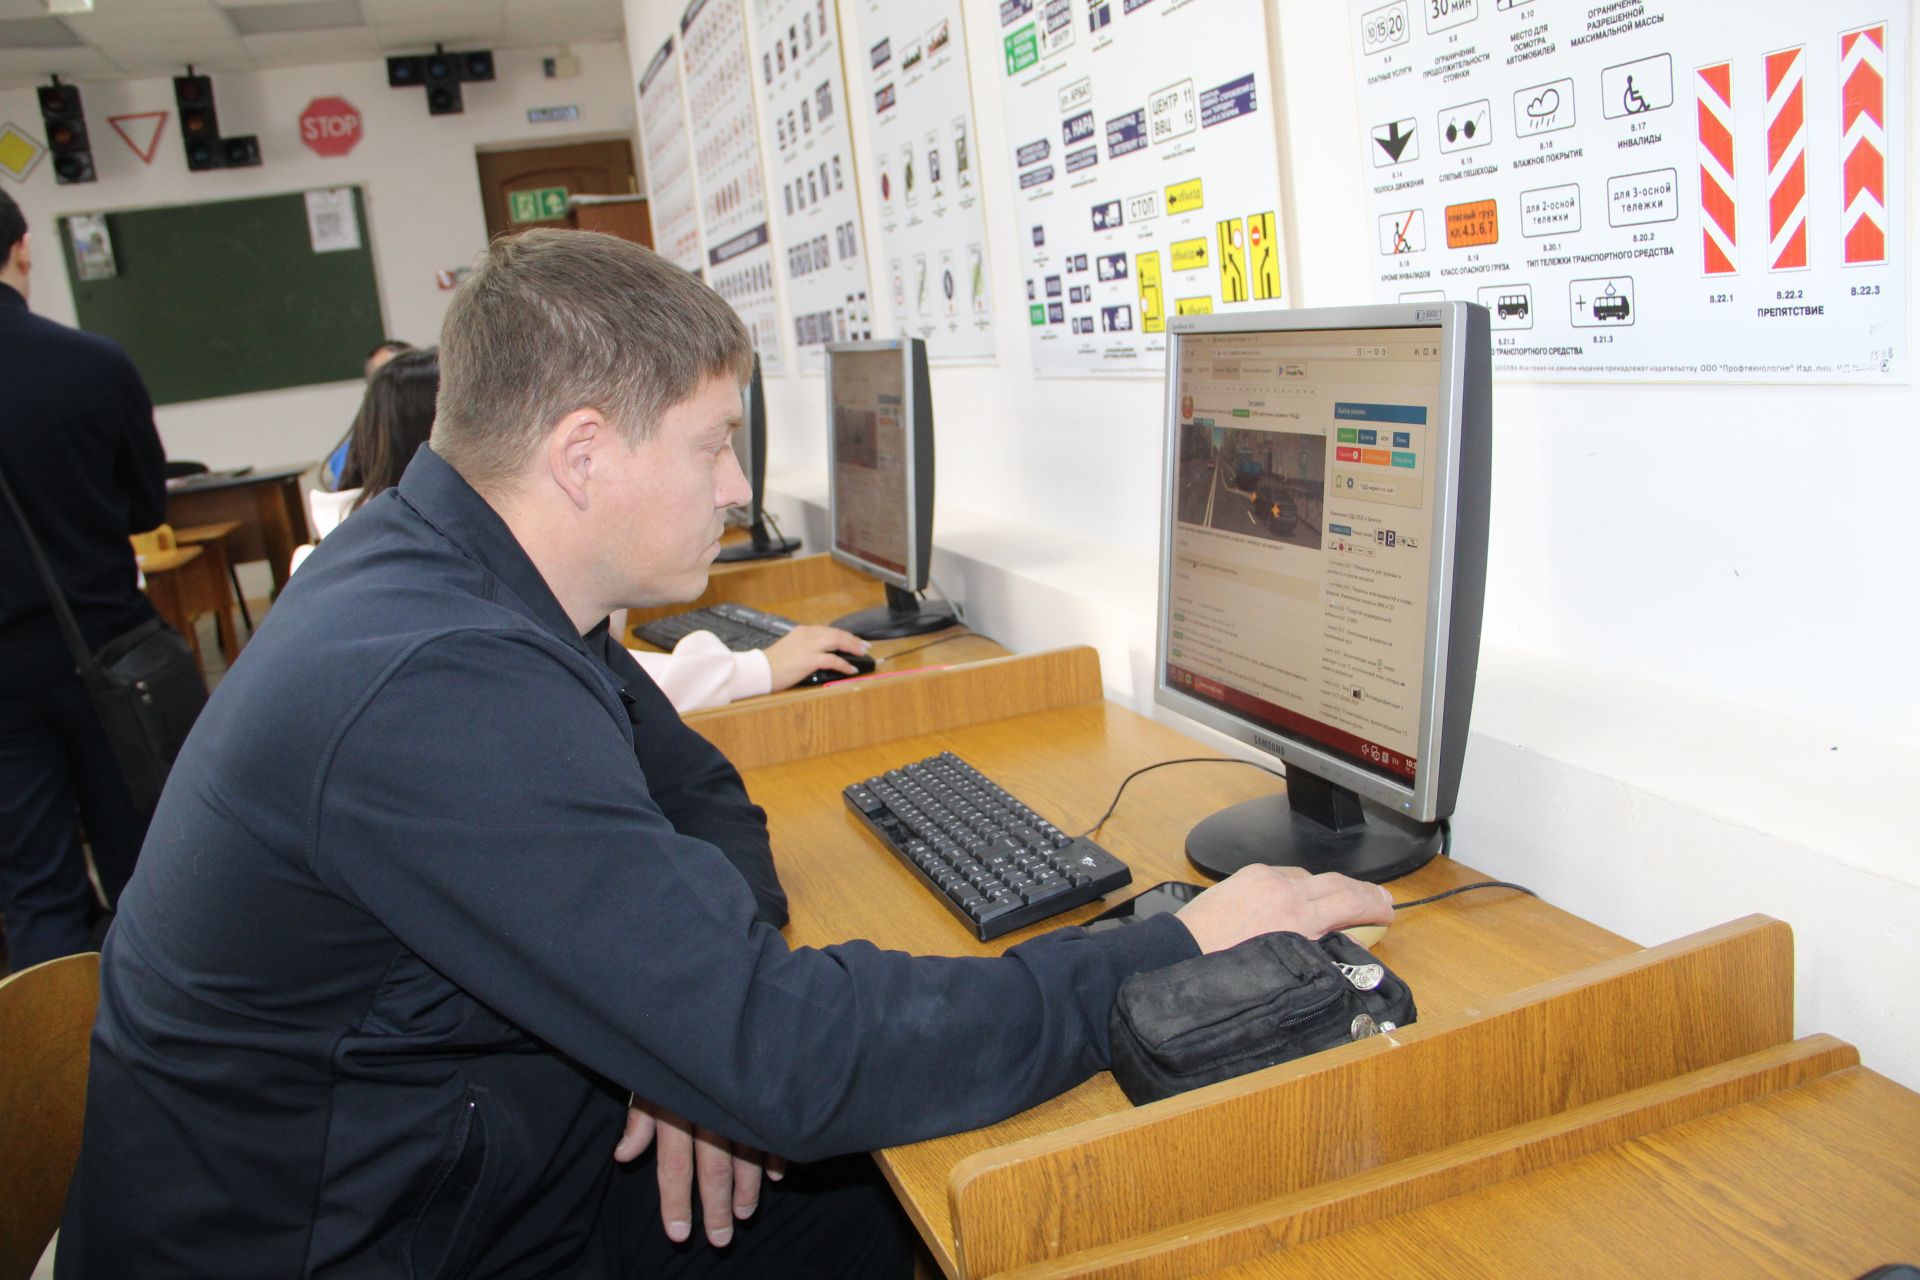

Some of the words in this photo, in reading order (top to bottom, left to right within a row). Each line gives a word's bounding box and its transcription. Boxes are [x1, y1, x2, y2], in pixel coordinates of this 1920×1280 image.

[1432, 0, 1448, 19] 30
[1377, 22, 1386, 37] 15
[1388, 15, 1402, 35] 20
[1587, 6, 1644, 31] РАЗРЕШЕННОЙ
[1510, 28, 1533, 43] МЕСТО
[1533, 24, 1549, 36] ДЛЯ
[1570, 22, 1633, 48] МАКСИМАЛЬНОЙ
[1634, 14, 1665, 30] МАССЫ
[1514, 37, 1547, 53] ОСМОТРА
[1434, 46, 1476, 65] ОГРАНИЧЕНИЕ
[1506, 43, 1556, 66] АВТОМОБИЛЕЙ
[1392, 66, 1412, 80] УСЛУГИ
[1423, 53, 1490, 78] ПРОДОЛЖИТЕЛЬНОСТИ
[1443, 70, 1470, 83] СТОЯНКИ
[1152, 92, 1178, 115] ЦЕНТР
[1184, 87, 1191, 103] 11
[304, 114, 357, 140] STOP
[1154, 117, 1172, 136] ВВЦ
[1185, 110, 1193, 125] 15
[1631, 122, 1646, 132] 8.17
[1617, 133, 1662, 149] ИНВАЛИДЫ
[1513, 155, 1545, 169] ВЛАЖНОЕ
[1546, 148, 1583, 163] ПОКРЫТИЕ
[1439, 171, 1462, 182] СЛЕПЫЕ
[1463, 165, 1498, 177] ПЕШЕХОДЫ
[1373, 182, 1394, 194] ПОЛОСА
[1614, 189, 1630, 201] для
[1632, 181, 1671, 198] 3-осной
[1526, 203, 1540, 214] для
[1542, 197, 1575, 211] 2-осной
[1621, 199, 1663, 213] тележки
[1533, 213, 1569, 225] тележки
[1633, 232, 1655, 243] 8.20.2
[1543, 243, 1561, 252] 8.20.1
[1526, 260, 1539, 268] ТИП
[1540, 256, 1571, 267] ТЕЛЕЖКИ
[1572, 250, 1633, 264] ТРАНСПОРТНОГО
[1634, 246, 1674, 258] СРЕДСТВА
[1399, 270, 1431, 281] ИНВАЛИДОВ
[1441, 266, 1459, 277] КЛАСС
[1460, 265, 1491, 276] ОПАСНОГО
[1491, 263, 1510, 272] ГРУЗА
[1709, 294, 1733, 303] 8.22.1
[1776, 290, 1803, 300] 8.22.2
[1850, 285, 1880, 296] 8.22.3
[1757, 305, 1825, 318] ПРЕПЯТСТВИЕ
[1593, 335, 1614, 344] 8.21.3
[1496, 347, 1548, 356] ТРАНСПОРТНОГО
[1548, 347, 1583, 356] СРЕДСТВА
[1700, 364, 1717, 372] ООО
[1254, 735, 1285, 756] SAMSUNG
